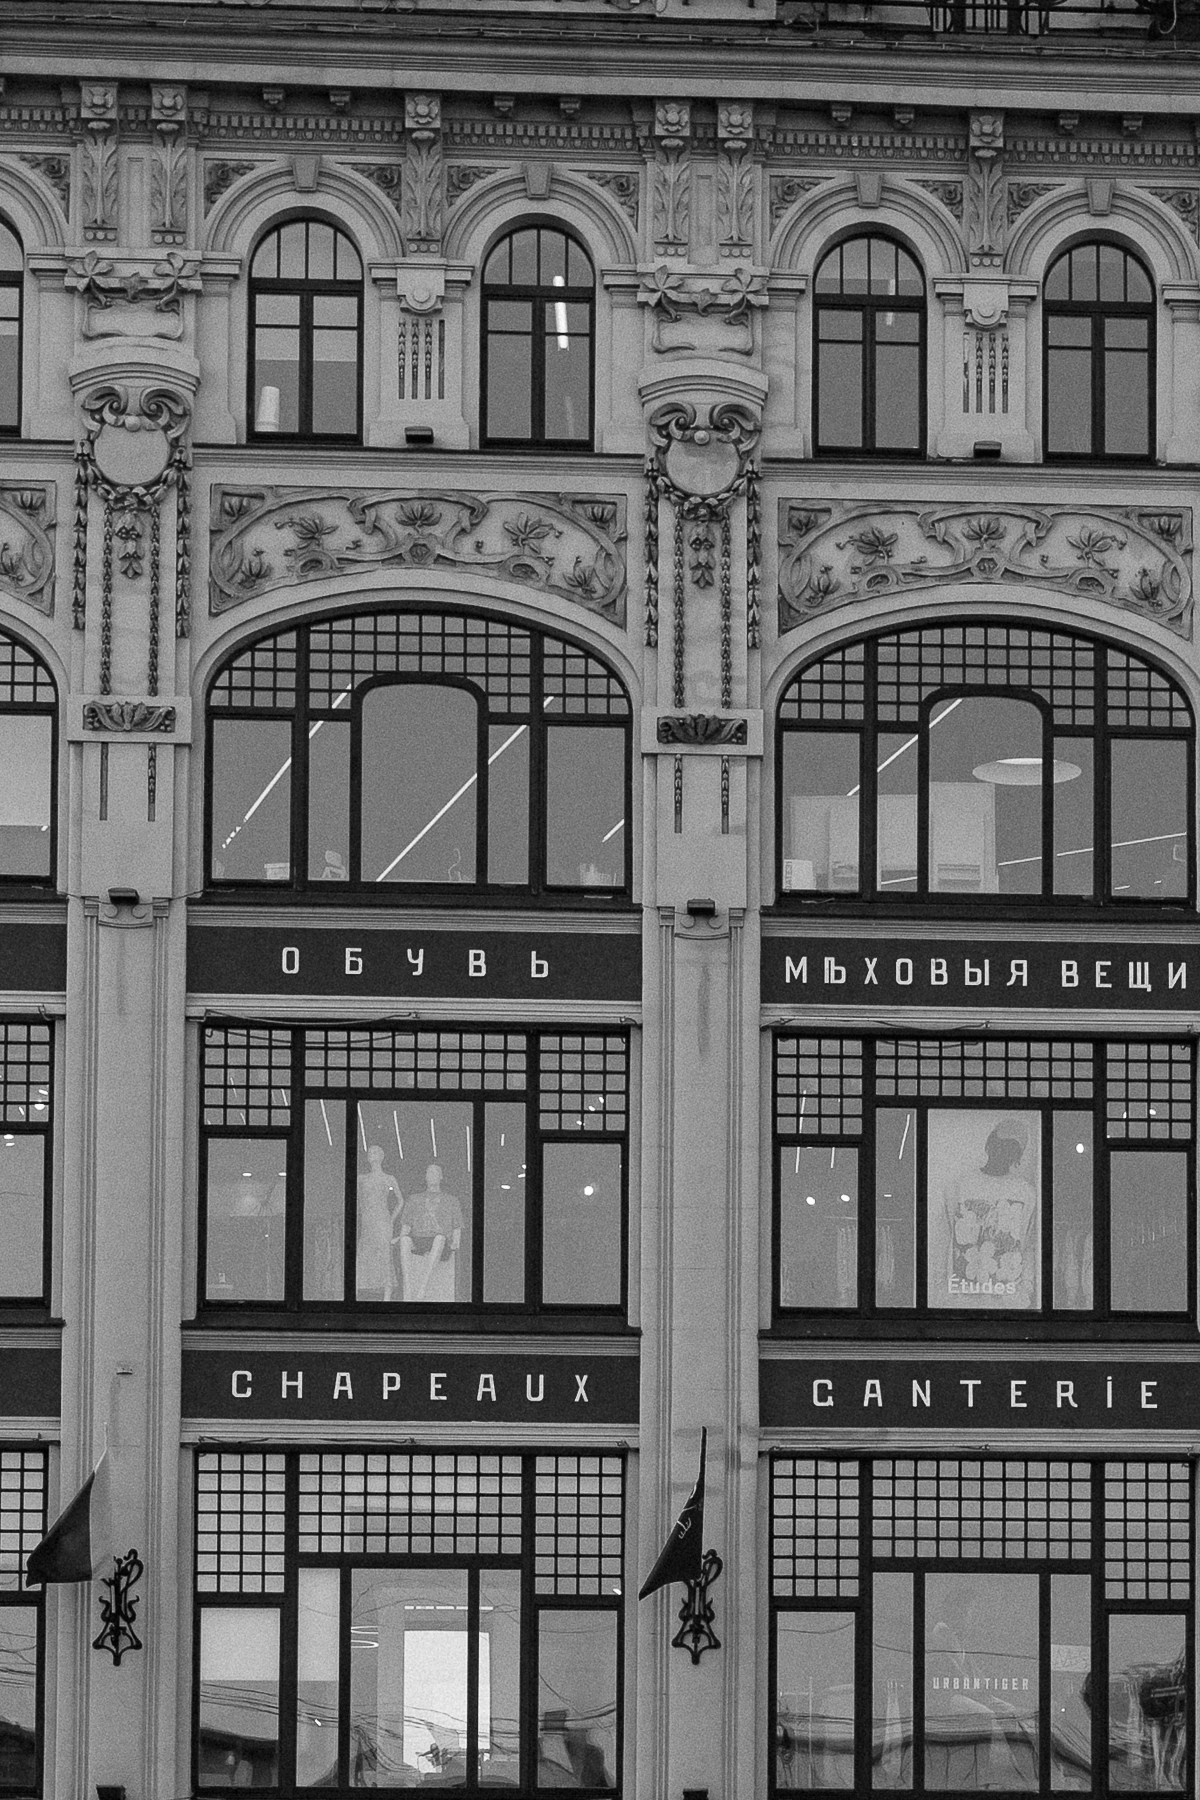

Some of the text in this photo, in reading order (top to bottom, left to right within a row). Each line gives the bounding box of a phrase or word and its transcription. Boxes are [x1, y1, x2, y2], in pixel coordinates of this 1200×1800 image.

[281, 946, 549, 978] ОБУВЬ
[1061, 959, 1187, 993] ВЕЩИ
[947, 1273, 1017, 1295] Études
[231, 1370, 589, 1403] CHAPEAUX
[932, 1677, 1029, 1691] URBANTIGER
